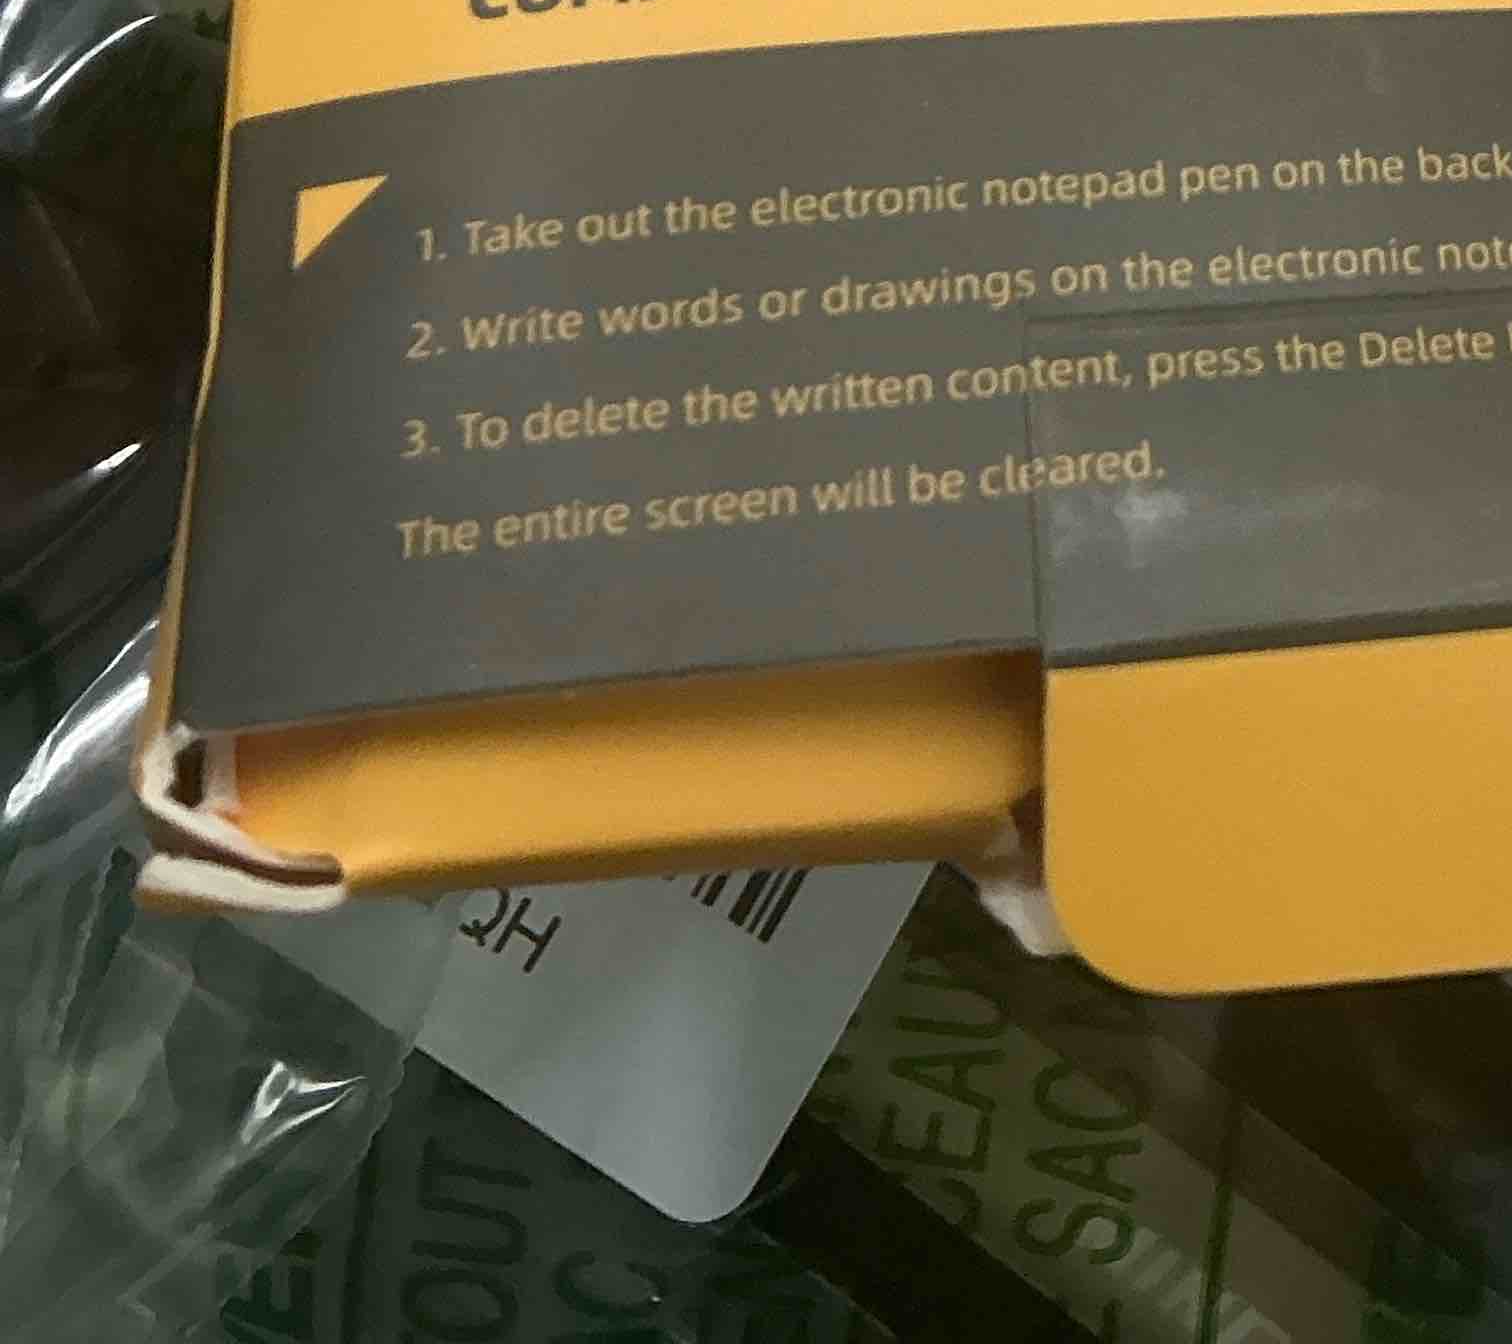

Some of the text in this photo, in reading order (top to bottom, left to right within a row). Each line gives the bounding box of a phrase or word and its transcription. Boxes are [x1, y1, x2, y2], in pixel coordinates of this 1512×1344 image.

[464, 214, 563, 258] Take
[576, 207, 654, 246] out
[664, 194, 739, 235] the
[751, 175, 967, 228] electronic
[981, 159, 1166, 210] notepad
[1179, 159, 1260, 202] pen
[1272, 157, 1328, 191] on
[1338, 146, 1404, 185] the
[462, 305, 584, 353] Write
[598, 291, 744, 336] words
[759, 287, 808, 322] or
[820, 261, 1036, 314] drawings
[1051, 264, 1108, 296] on
[1122, 250, 1192, 289] the
[1207, 238, 1425, 288] electronic
[455, 409, 508, 453] To
[522, 391, 671, 444] delete
[683, 384, 758, 428] the
[770, 370, 934, 418] written
[946, 348, 1134, 404] content,
[1146, 344, 1264, 390] press
[1275, 335, 1347, 376] the
[1359, 323, 1496, 368] Delete
[396, 438, 1167, 562] The entire screen will be cleared.
[398, 1138, 532, 1344] OUT
